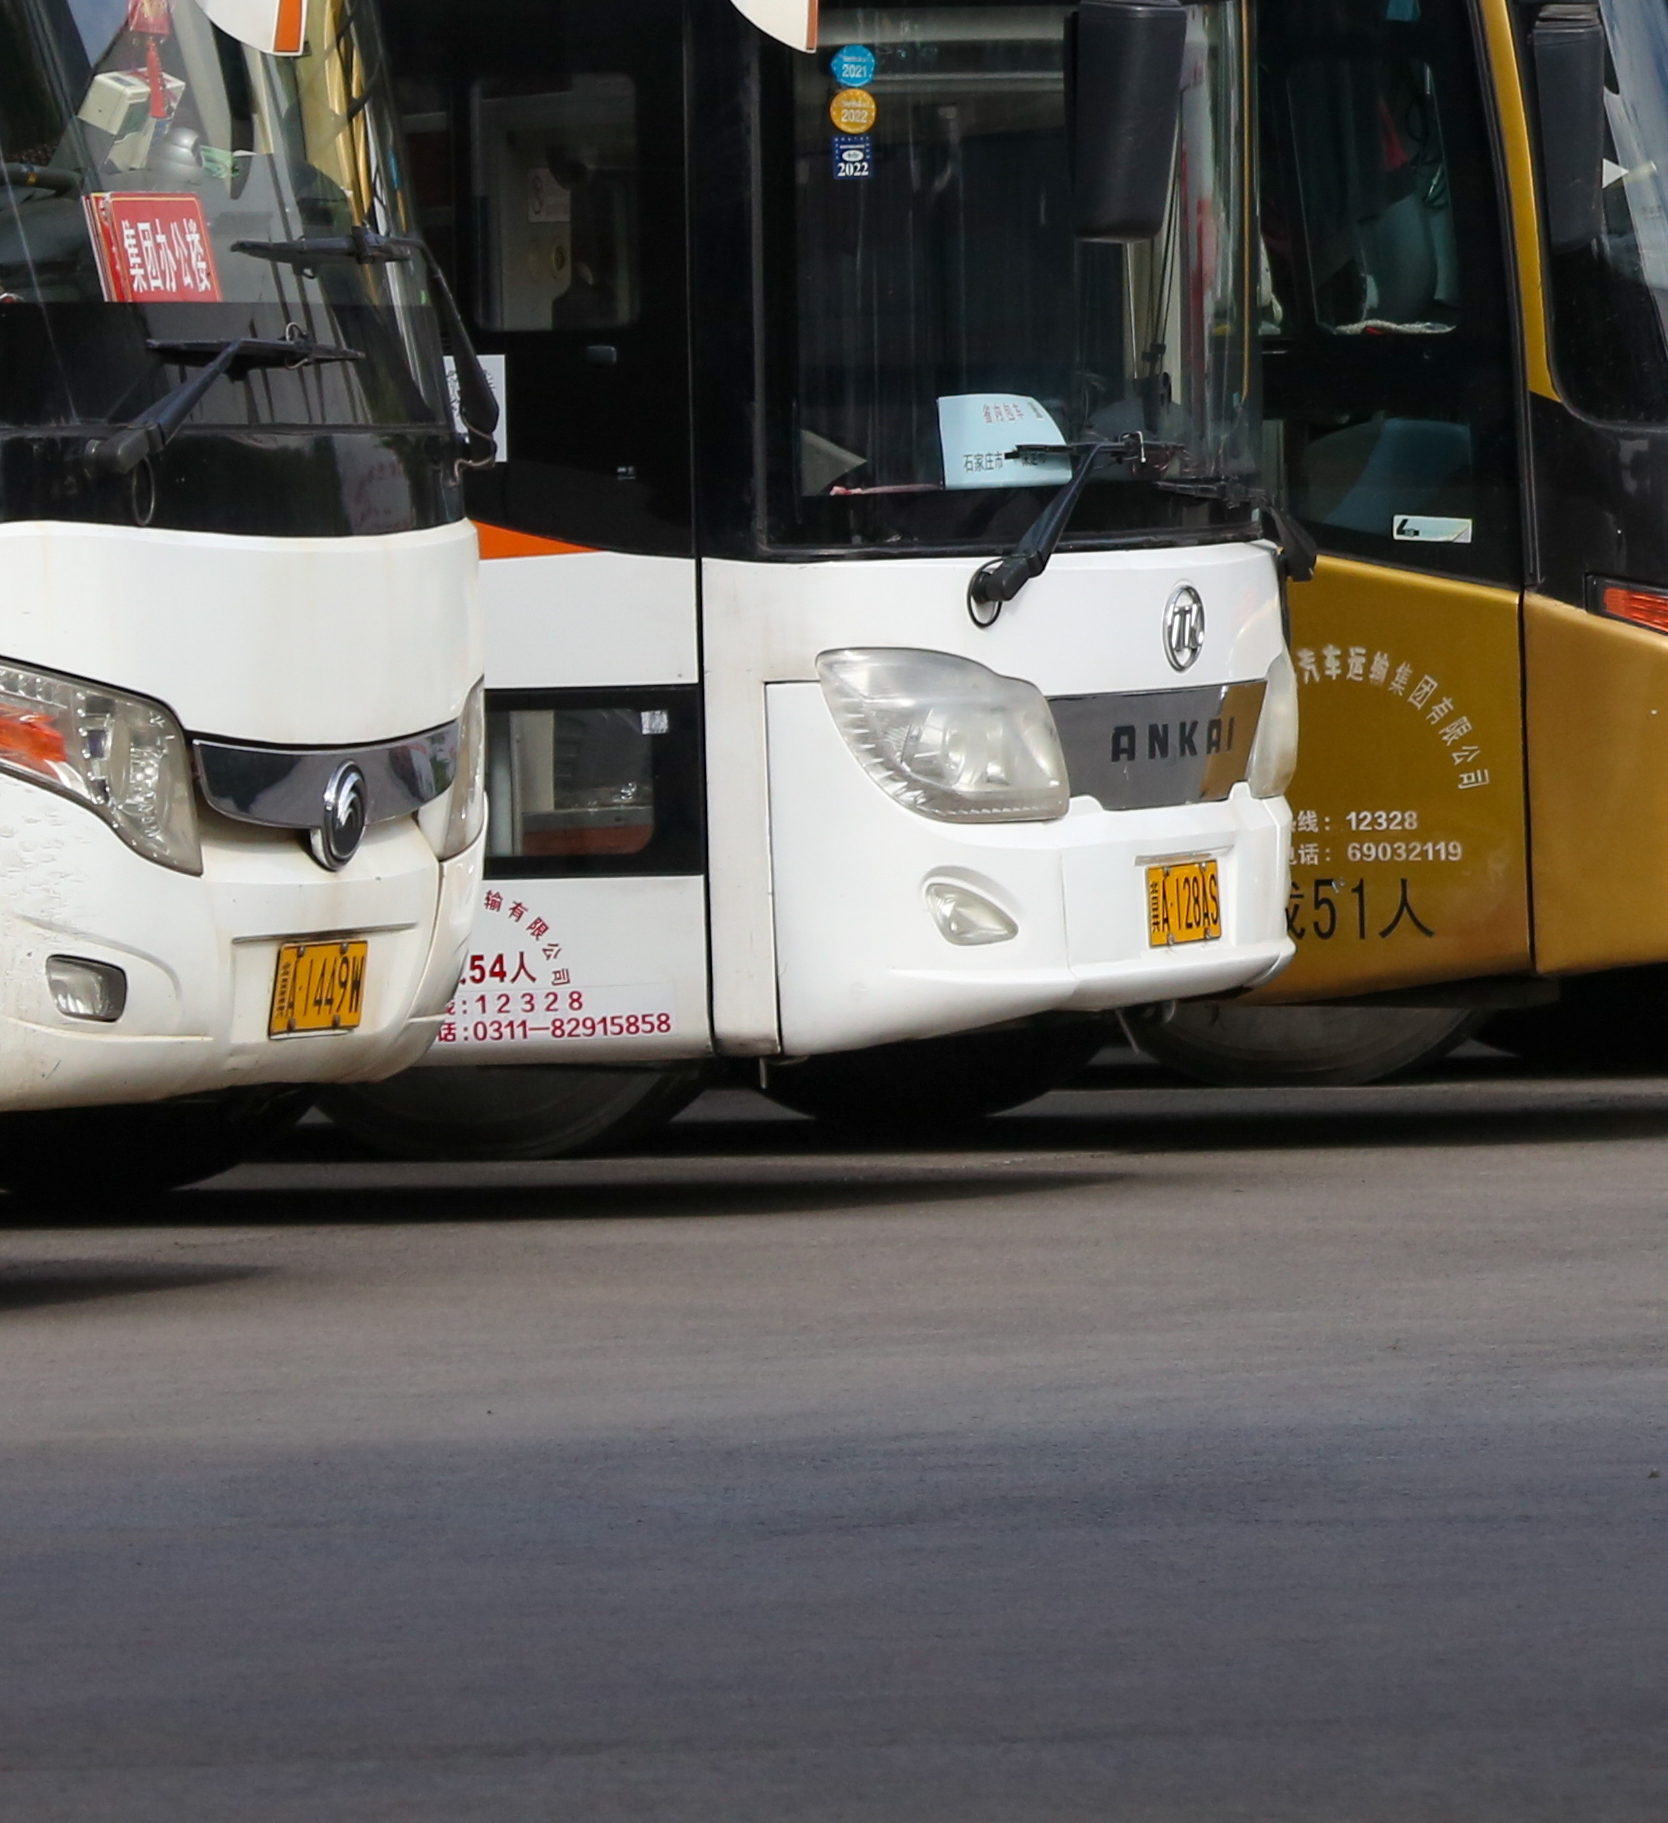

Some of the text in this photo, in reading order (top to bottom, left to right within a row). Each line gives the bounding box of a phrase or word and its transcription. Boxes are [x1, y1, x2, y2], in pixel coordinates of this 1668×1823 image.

[842, 63, 867, 78] 2021
[841, 108, 868, 123] 2022
[837, 161, 869, 177] 2022
[121, 218, 211, 294] 集团办公楼
[963, 451, 1004, 472] 石家庄市
[1110, 717, 1236, 763] ANKAI
[1345, 810, 1419, 832] 12328
[1347, 841, 1463, 863] 69032119
